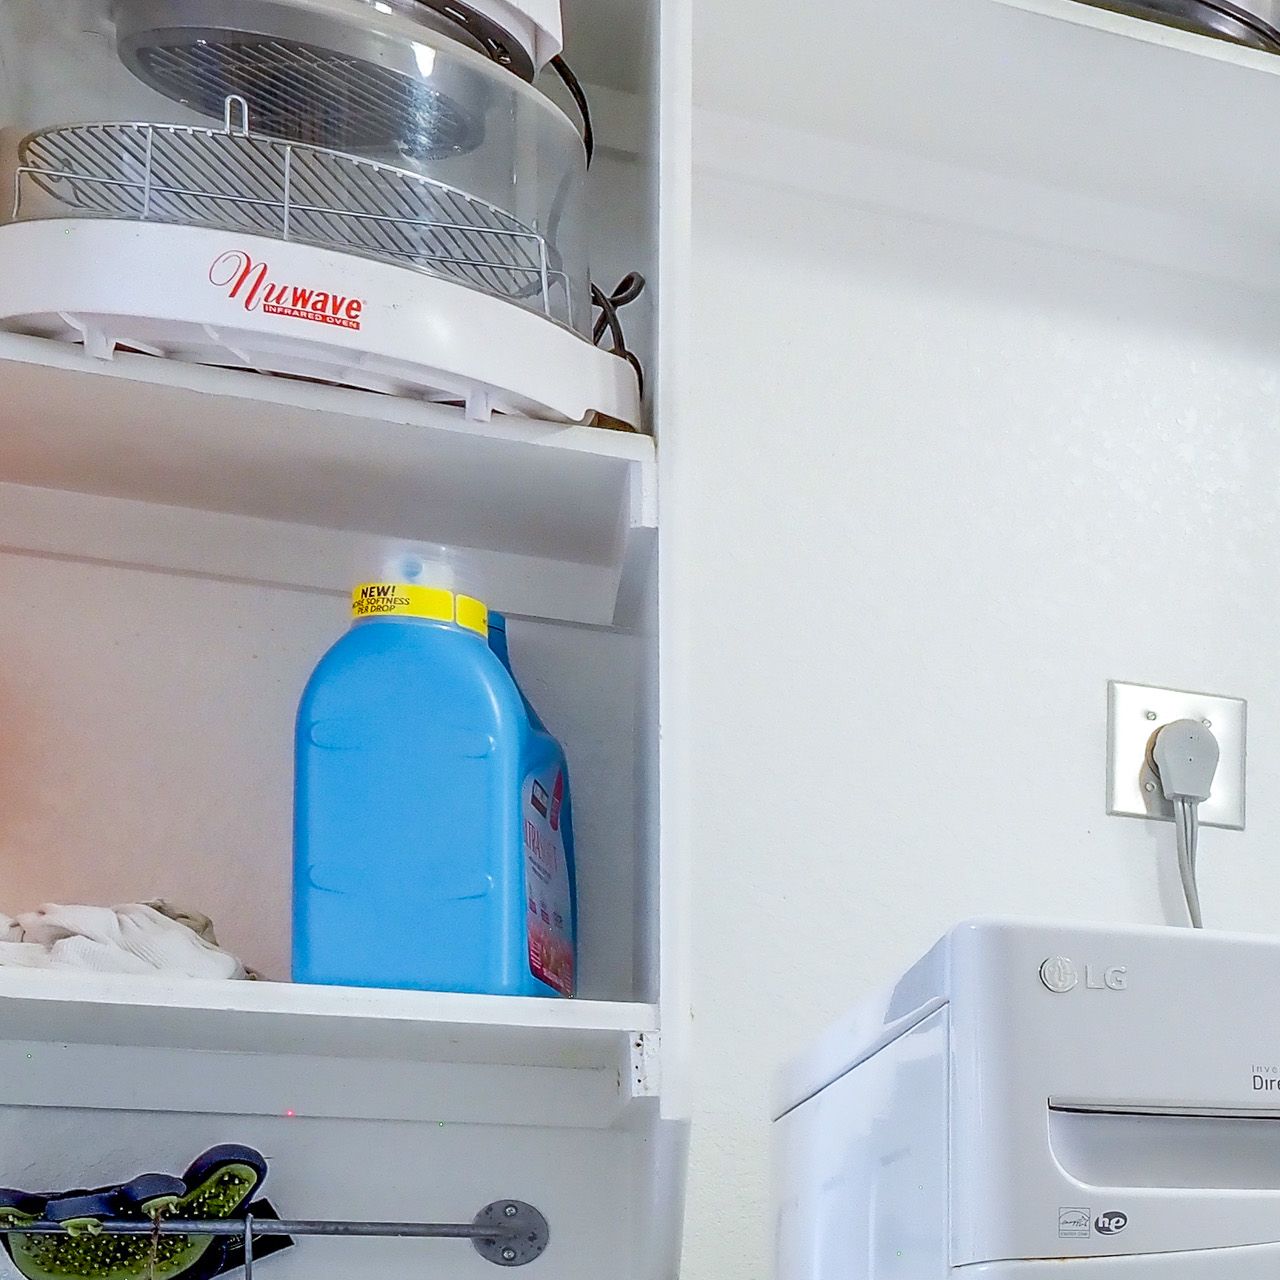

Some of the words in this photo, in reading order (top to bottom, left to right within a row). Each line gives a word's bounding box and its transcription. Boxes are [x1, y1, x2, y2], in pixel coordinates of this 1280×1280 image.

[265, 305, 323, 322] INFRARED
[327, 317, 359, 329] OVEN
[361, 585, 396, 599] NEW!
[366, 597, 410, 606] SOFTNESS
[358, 605, 369, 614] PER
[370, 605, 396, 613] DROP
[1085, 964, 1128, 991] LG
